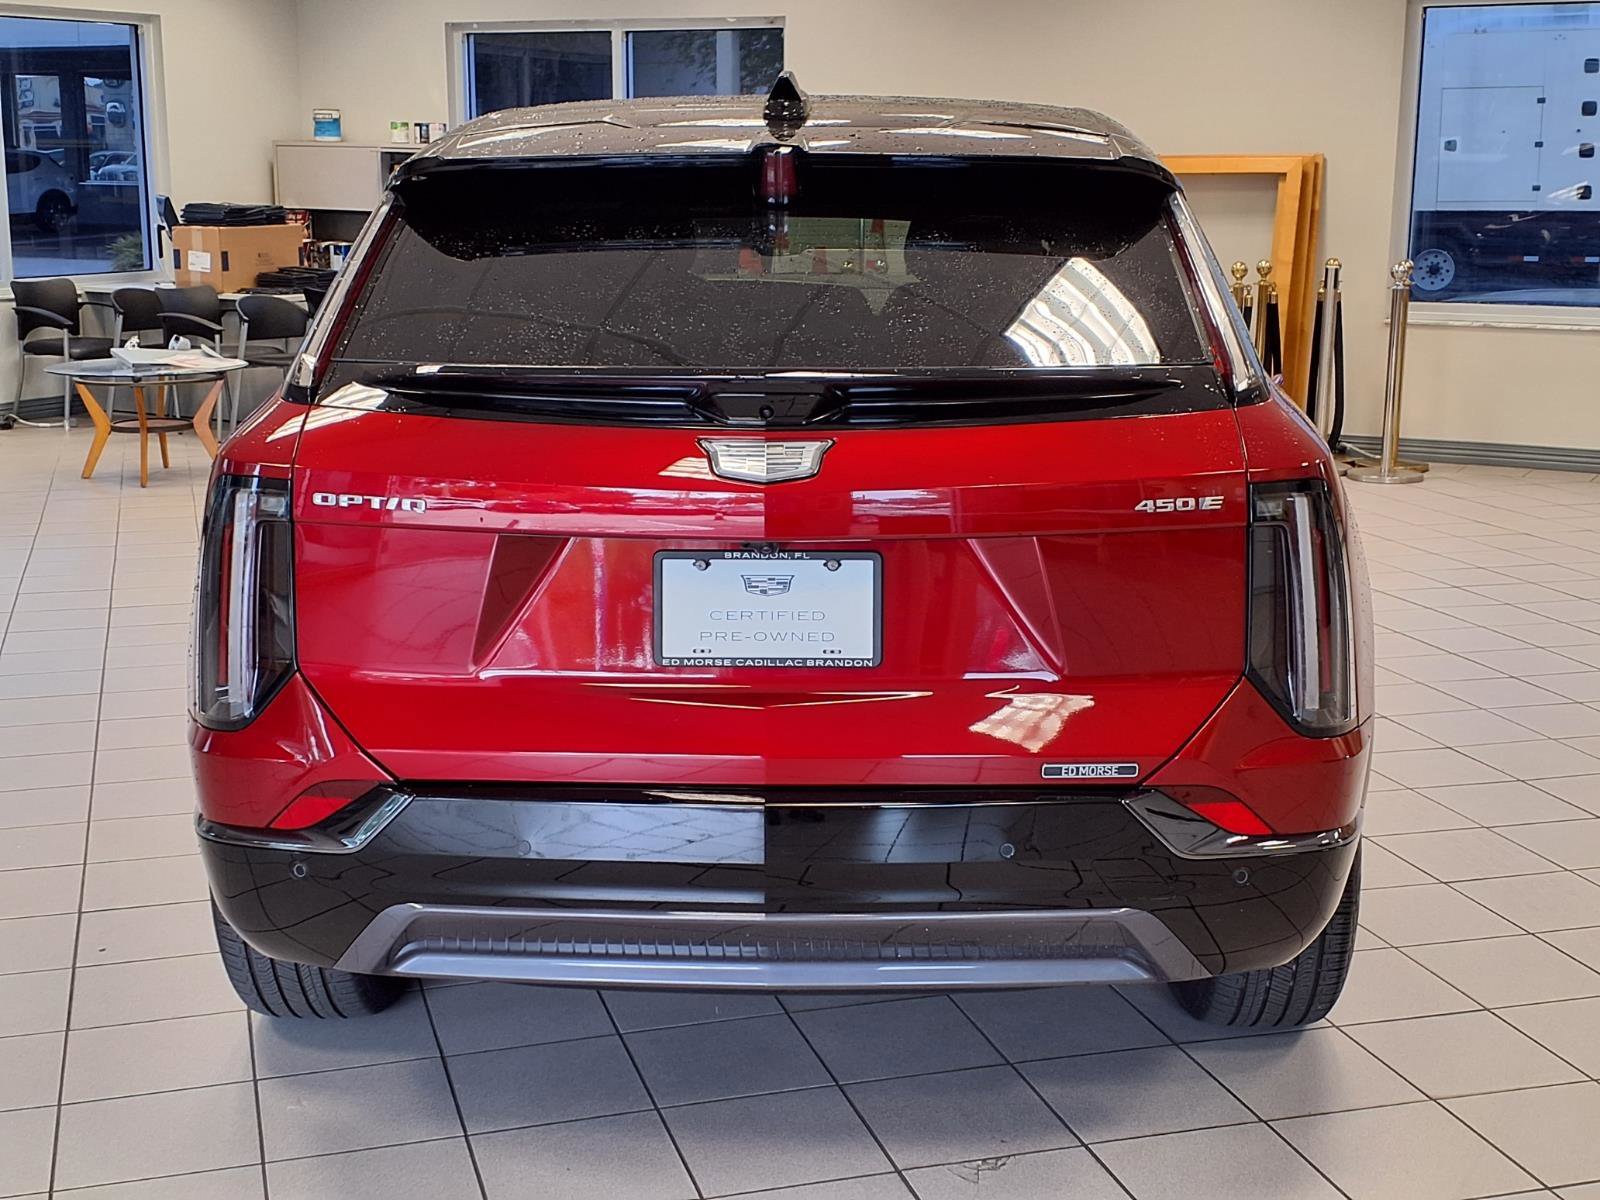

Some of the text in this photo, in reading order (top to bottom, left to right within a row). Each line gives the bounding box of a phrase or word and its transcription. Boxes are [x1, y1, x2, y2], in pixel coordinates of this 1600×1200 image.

[794, 551, 810, 559] FL
[709, 610, 826, 621] CERTIFIED
[699, 631, 835, 642] PRE-OWNED
[662, 658, 873, 668] ED MORSE CADILLAC BRANDON
[1061, 766, 1119, 776] ED MORSE
